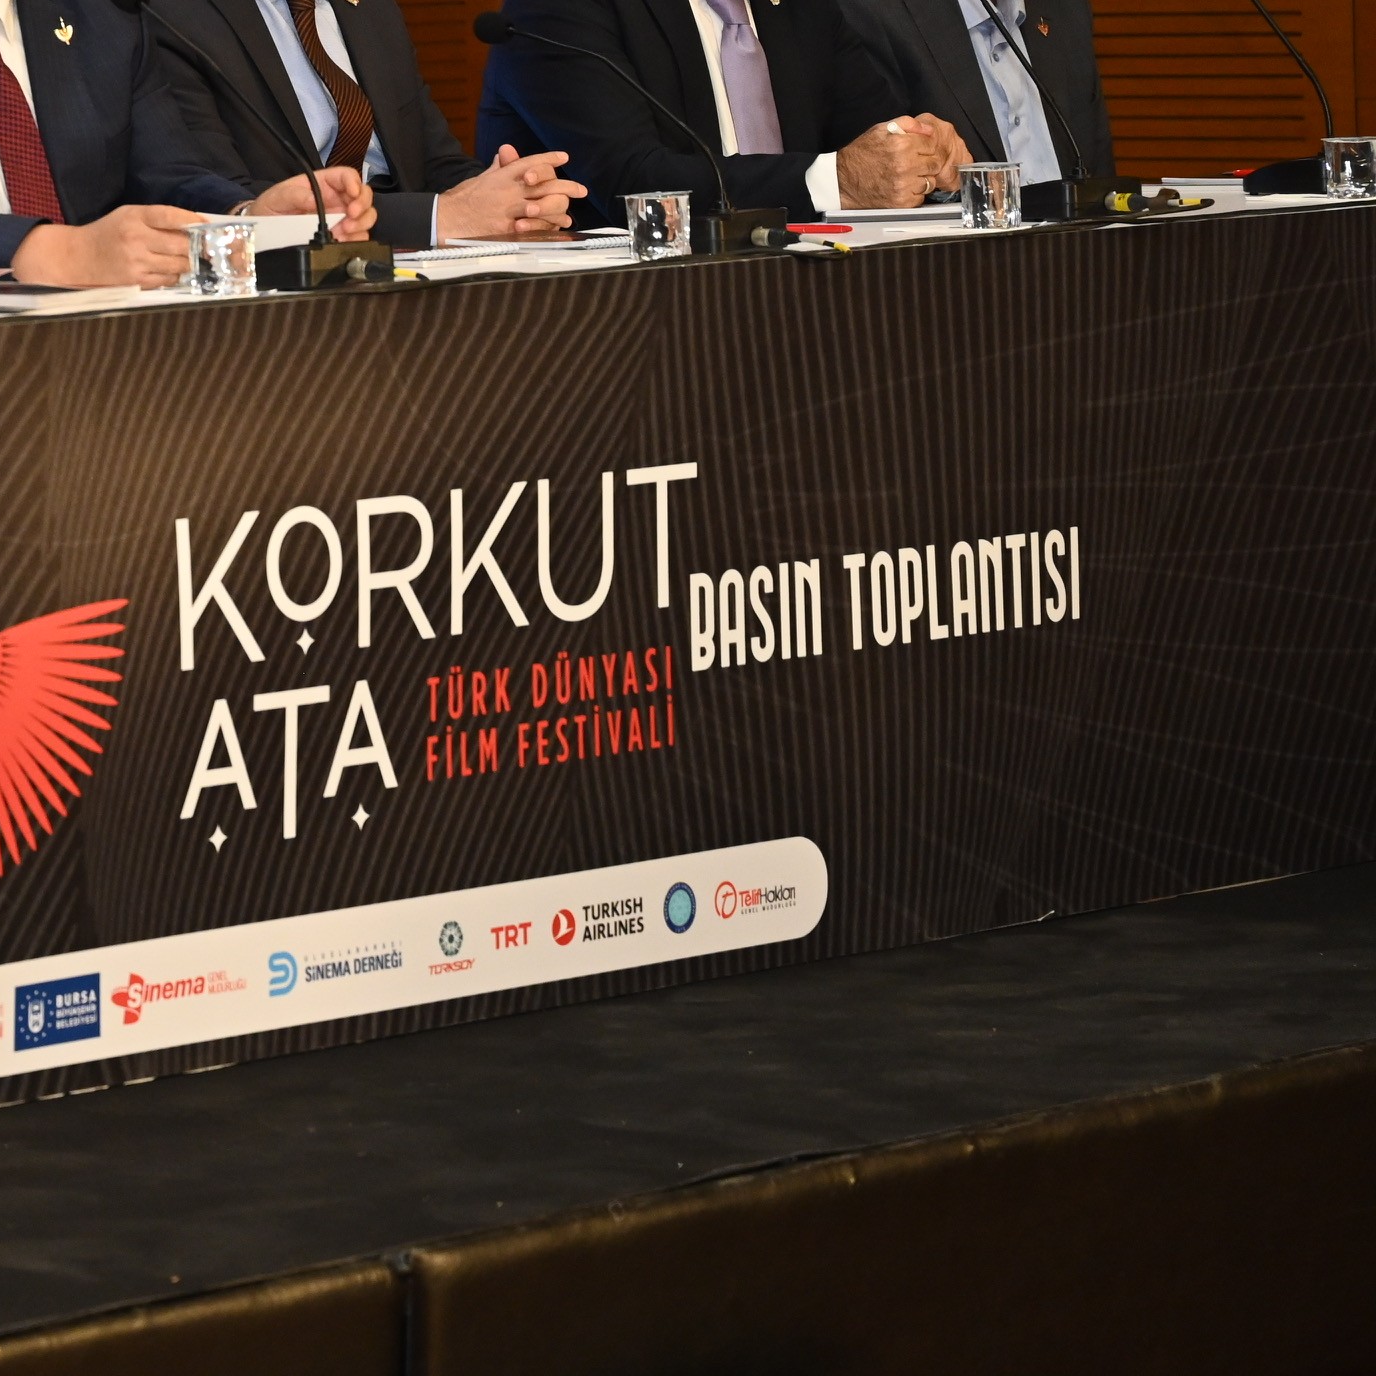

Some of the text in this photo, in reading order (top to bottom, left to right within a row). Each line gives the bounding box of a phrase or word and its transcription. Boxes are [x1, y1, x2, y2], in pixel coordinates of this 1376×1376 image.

[175, 461, 698, 672] KORKUT
[689, 526, 1080, 672] BASIN TOPLANTISI
[427, 645, 674, 722] TÜRK DÜNYASI
[179, 679, 398, 840] ATA
[426, 694, 676, 782] FİLM FESTİVALİ
[491, 922, 532, 949] TRT
[582, 897, 643, 922] TURKISH
[582, 916, 644, 942] AIRLINES
[56, 989, 97, 1008] BURSA
